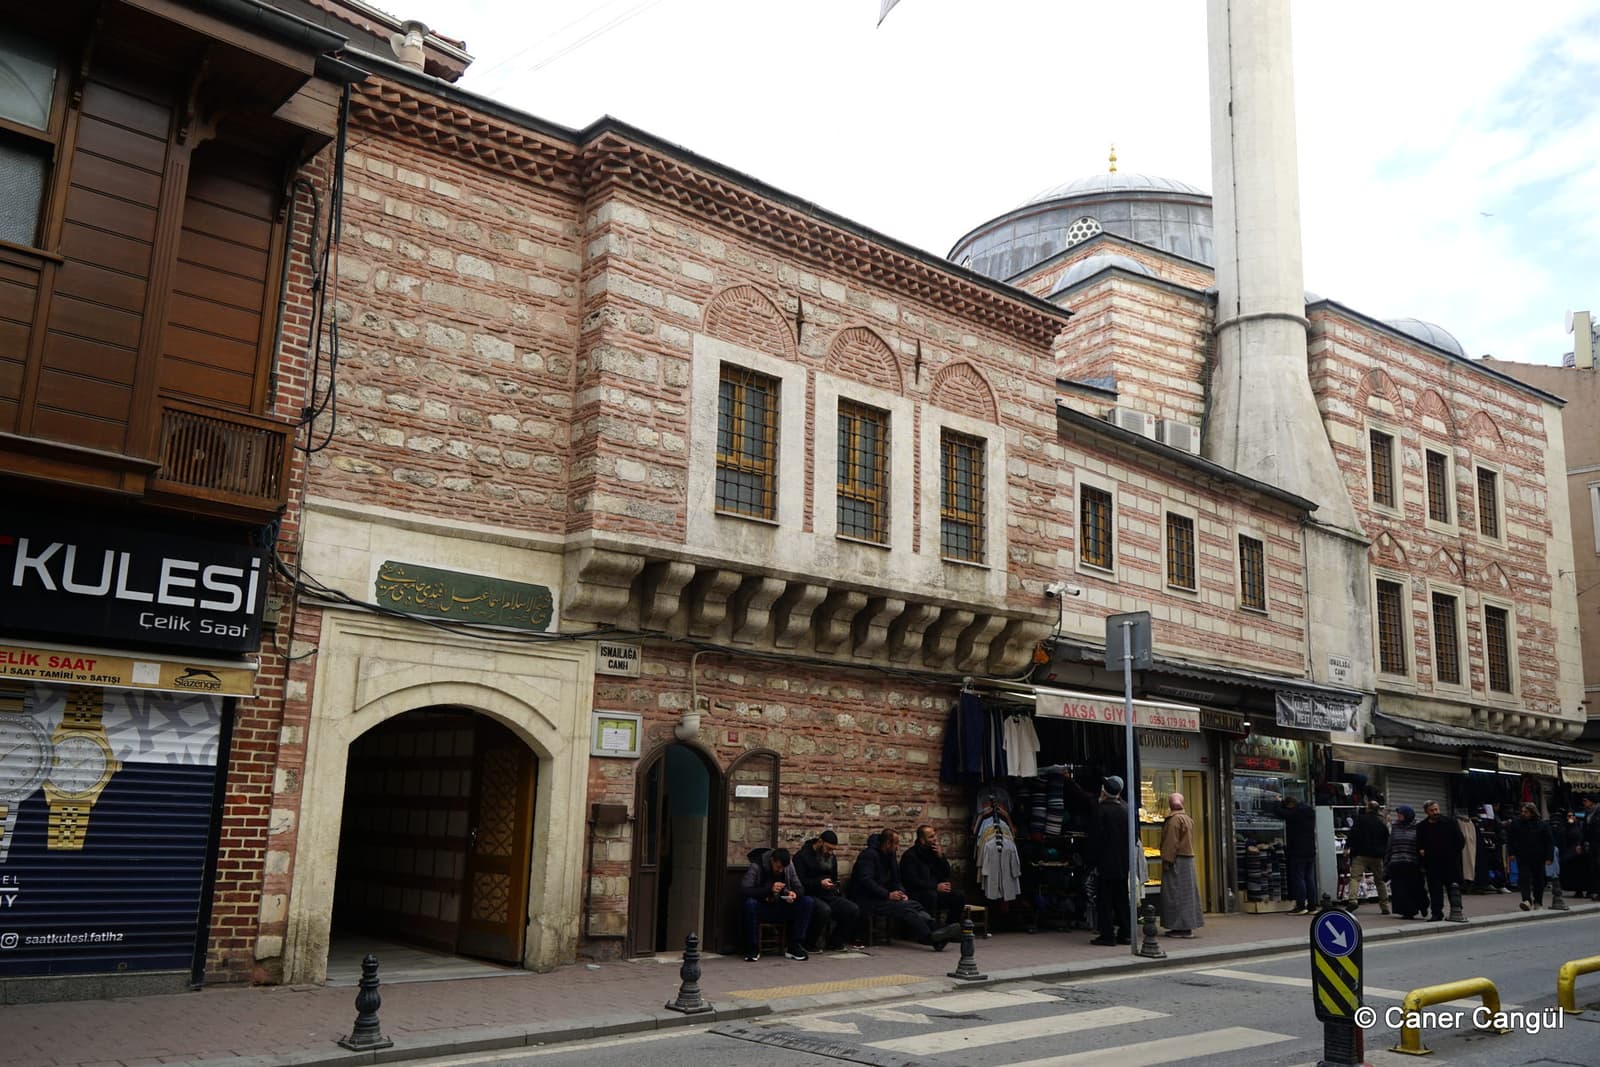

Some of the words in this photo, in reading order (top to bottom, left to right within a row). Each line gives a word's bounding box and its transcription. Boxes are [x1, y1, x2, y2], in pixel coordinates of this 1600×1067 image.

[139, 611, 192, 632] Çelik
[200, 618, 249, 638] Saat
[48, 656, 97, 671] SAAT
[10, 667, 37, 676] SAAT
[174, 676, 223, 690] Slazenger
[1063, 703, 1096, 719] AKSA
